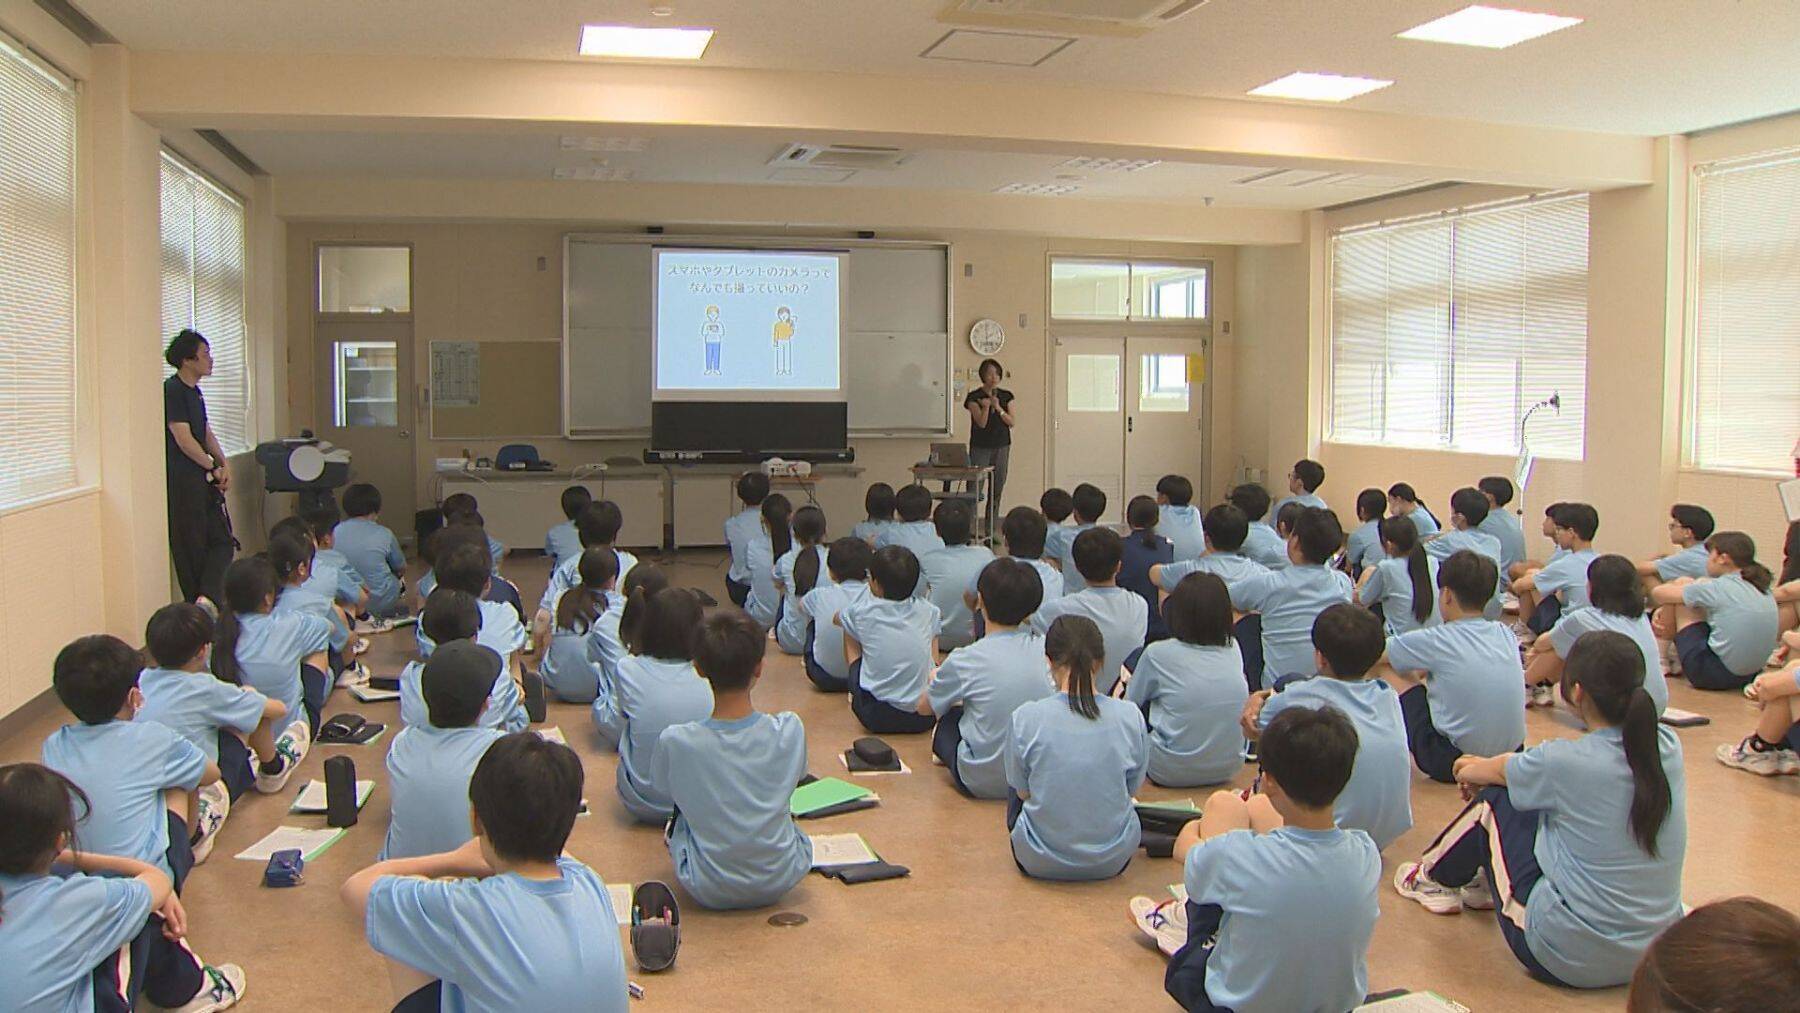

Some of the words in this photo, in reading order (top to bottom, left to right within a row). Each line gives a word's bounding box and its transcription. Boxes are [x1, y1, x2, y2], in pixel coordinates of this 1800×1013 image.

[668, 264, 832, 279] スマホやタブレットのカメラって
